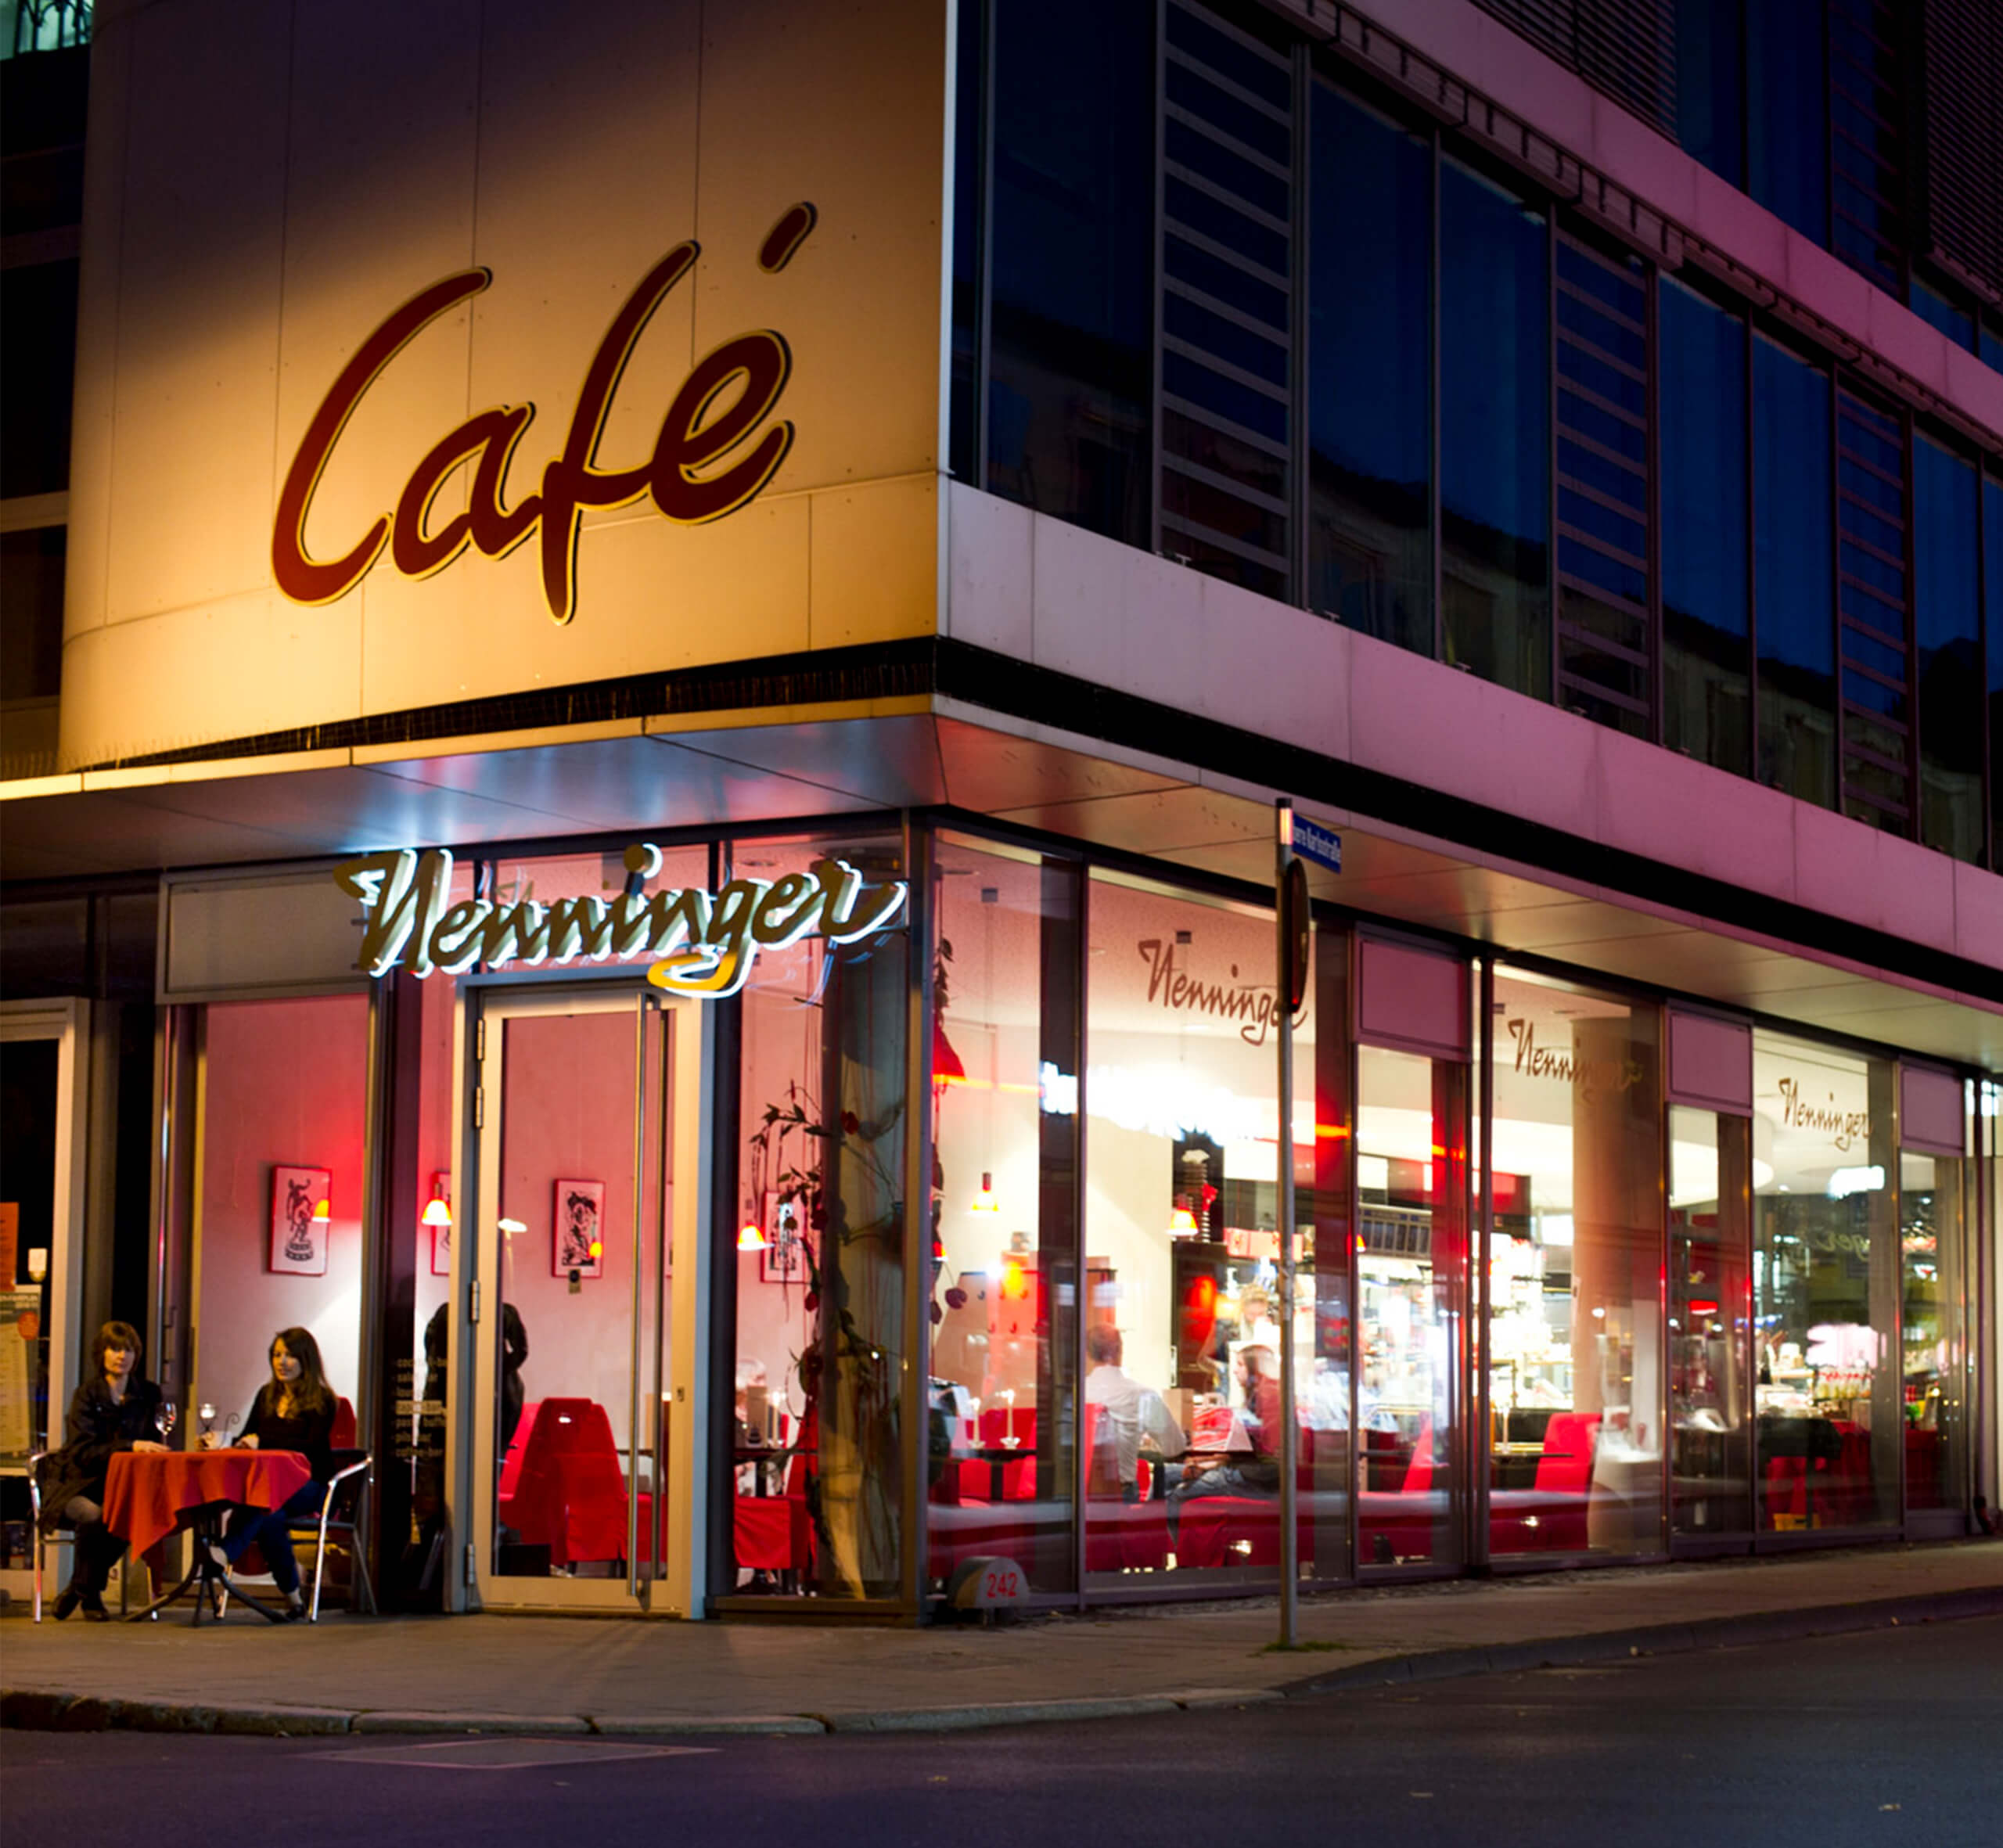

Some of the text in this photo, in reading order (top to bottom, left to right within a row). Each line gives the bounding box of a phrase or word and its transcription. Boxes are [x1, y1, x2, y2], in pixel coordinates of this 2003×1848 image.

[271, 201, 818, 626] Café
[333, 843, 908, 998] Nenninger
[1138, 939, 1307, 1045] Nenninge
[987, 1573, 1016, 1598] 242
